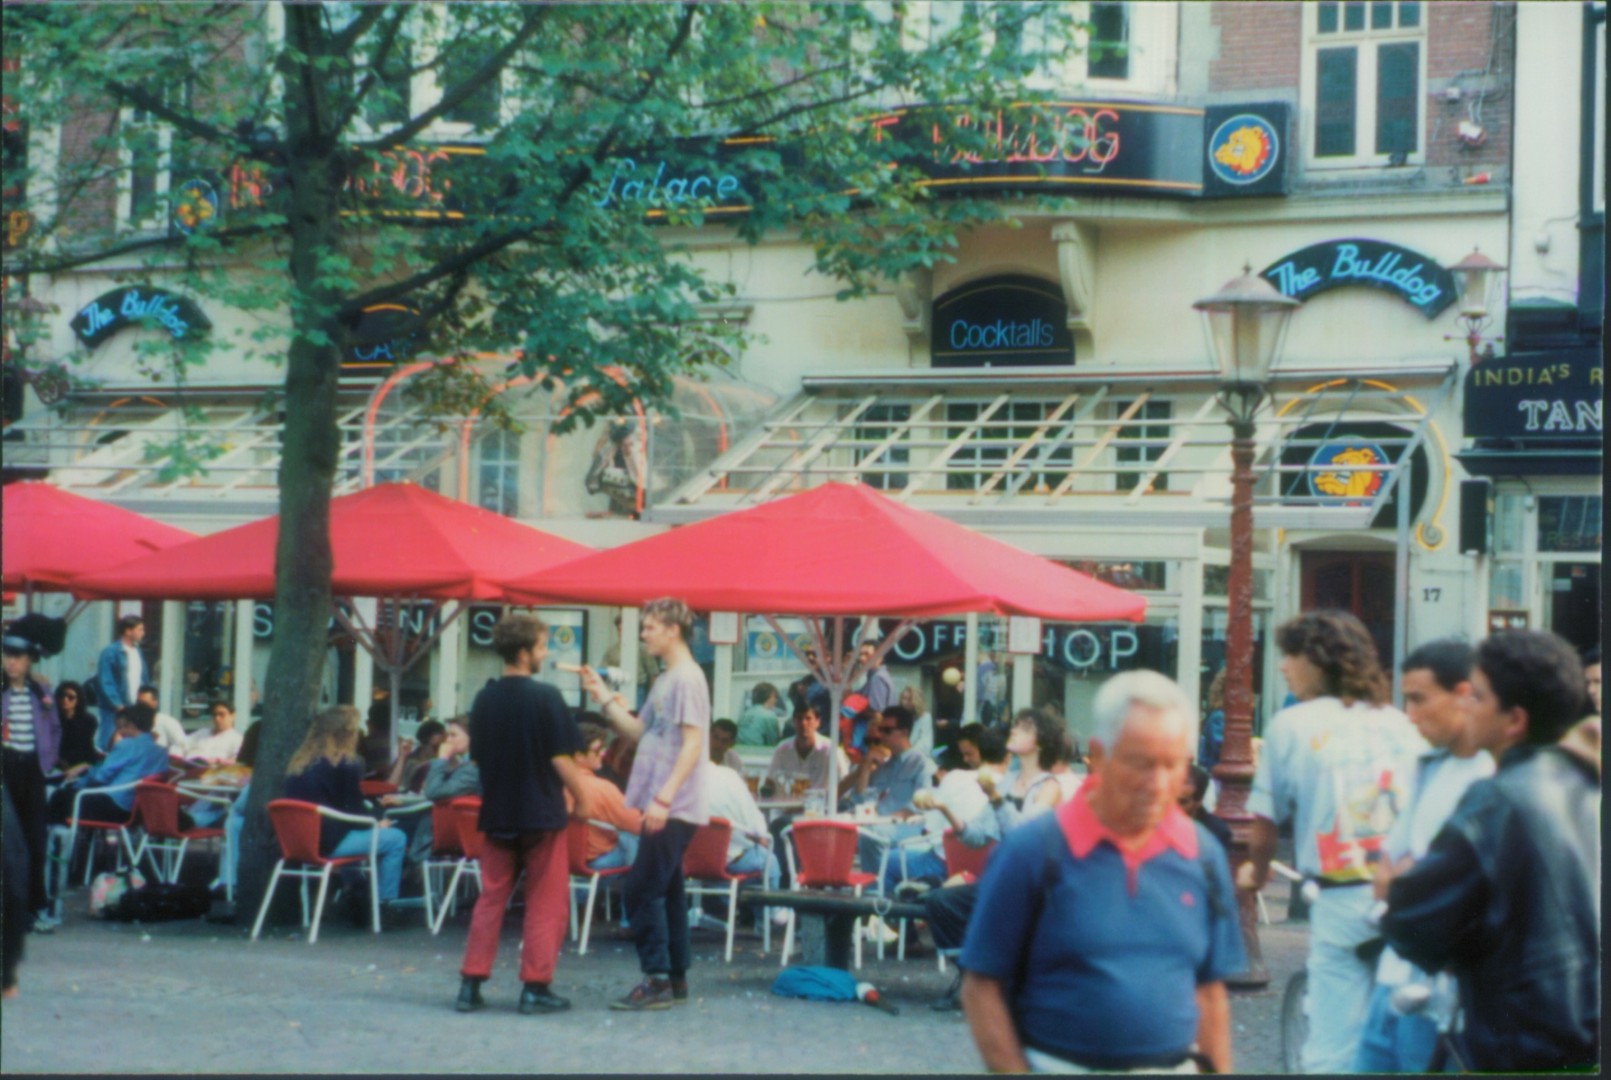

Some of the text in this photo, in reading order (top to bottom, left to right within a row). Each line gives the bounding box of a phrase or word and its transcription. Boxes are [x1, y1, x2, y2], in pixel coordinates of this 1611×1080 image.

[593, 157, 738, 206] Palace
[1267, 243, 1442, 305] The Bulldog
[81, 302, 116, 336] The
[1474, 363, 1571, 386] INDIA'S
[1422, 588, 1441, 602] 17
[1042, 628, 1139, 668] HOP
